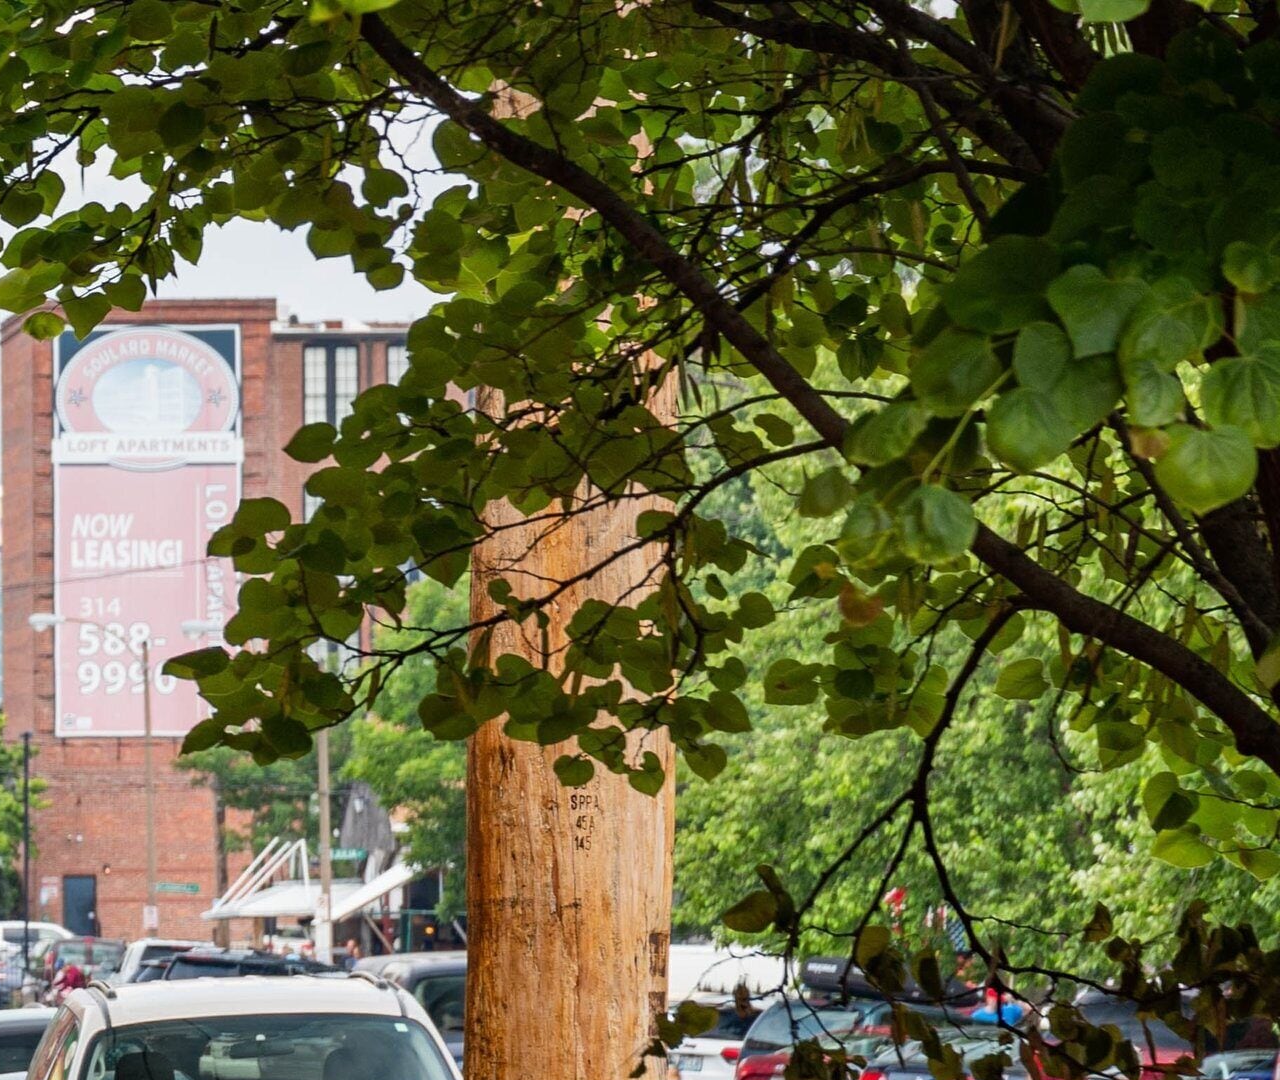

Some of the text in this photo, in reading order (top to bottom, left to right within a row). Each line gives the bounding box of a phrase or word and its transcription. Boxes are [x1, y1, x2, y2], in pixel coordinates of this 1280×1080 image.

[82, 339, 215, 378] SOULARD MARKET
[68, 438, 231, 453] LOFT APARTMENTS
[71, 514, 133, 537] NOW
[71, 539, 184, 569] LEASING!
[79, 598, 121, 617] 314
